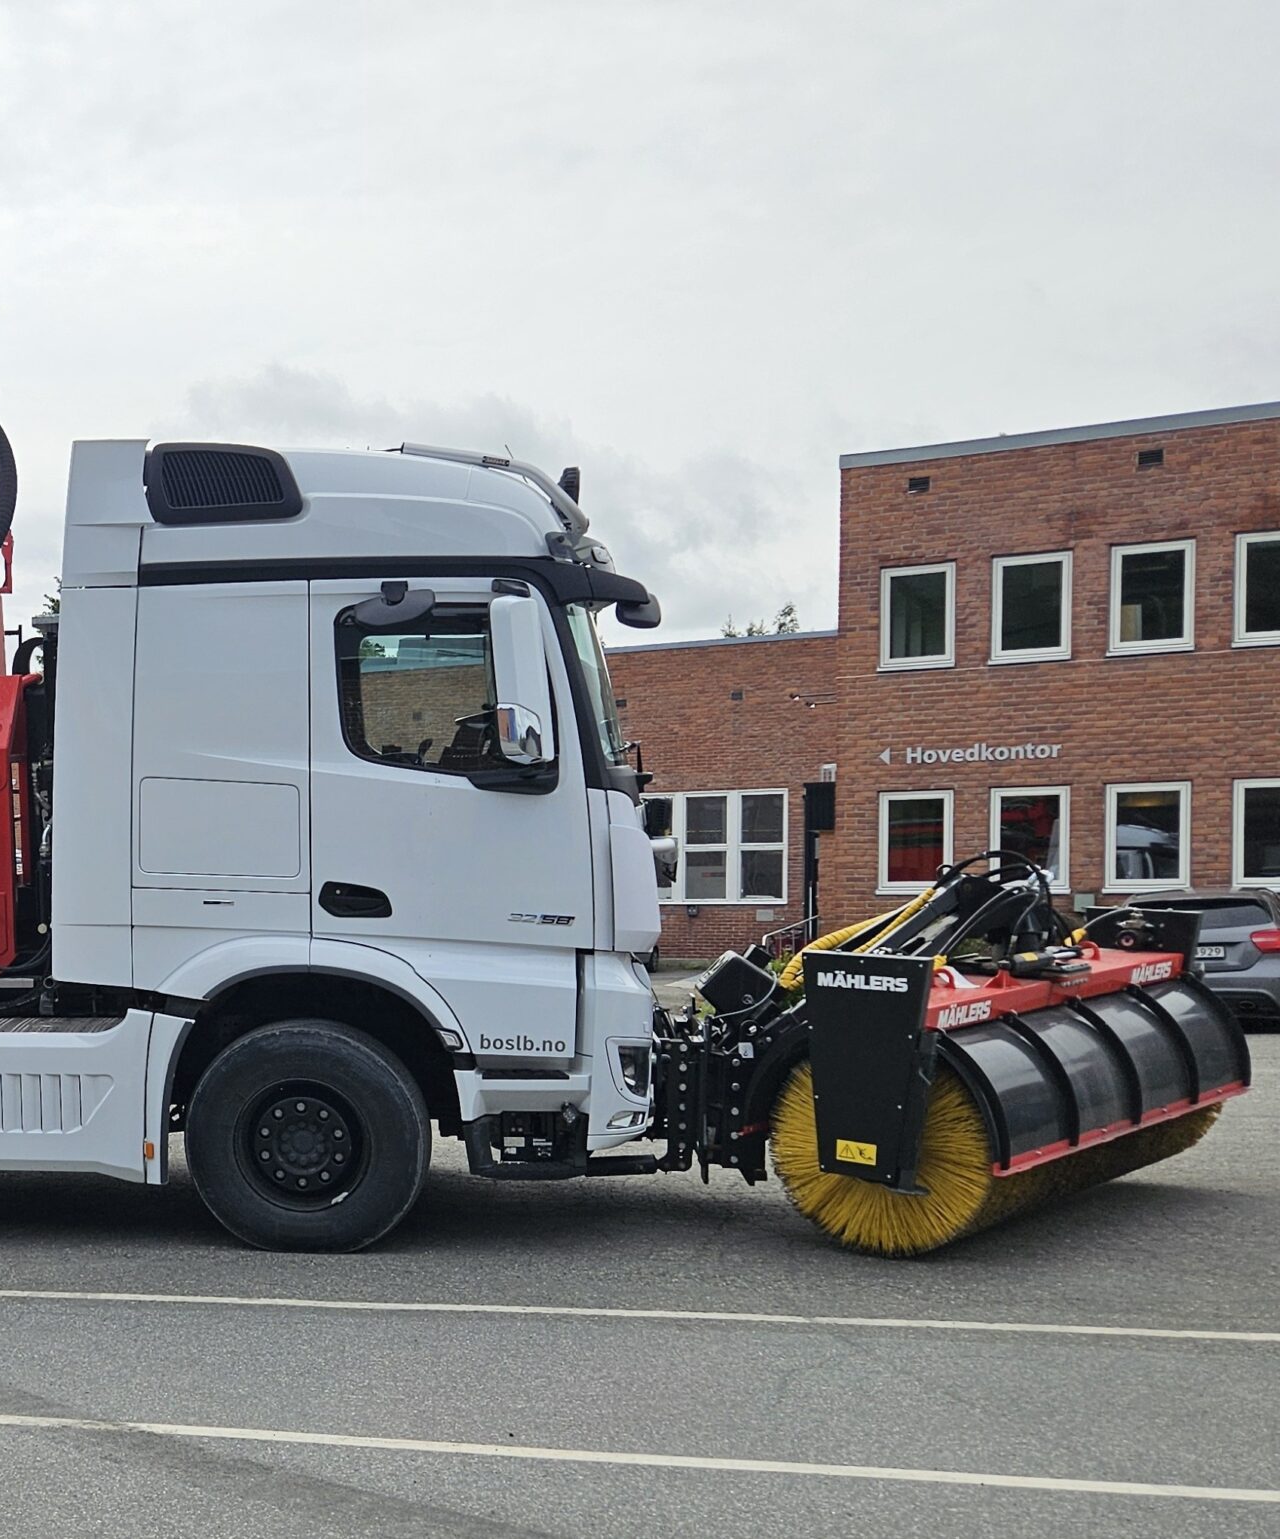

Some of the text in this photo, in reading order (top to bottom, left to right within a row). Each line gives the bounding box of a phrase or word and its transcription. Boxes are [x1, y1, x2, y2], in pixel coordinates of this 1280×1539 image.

[906, 742, 1062, 764] Hovedkontor
[1196, 947, 1222, 957] 929
[817, 970, 909, 993] MÄHLERS
[1130, 961, 1172, 984] MÄHLERS
[937, 999, 992, 1028] MÄHLERS
[480, 1033, 566, 1053] boslb.no
